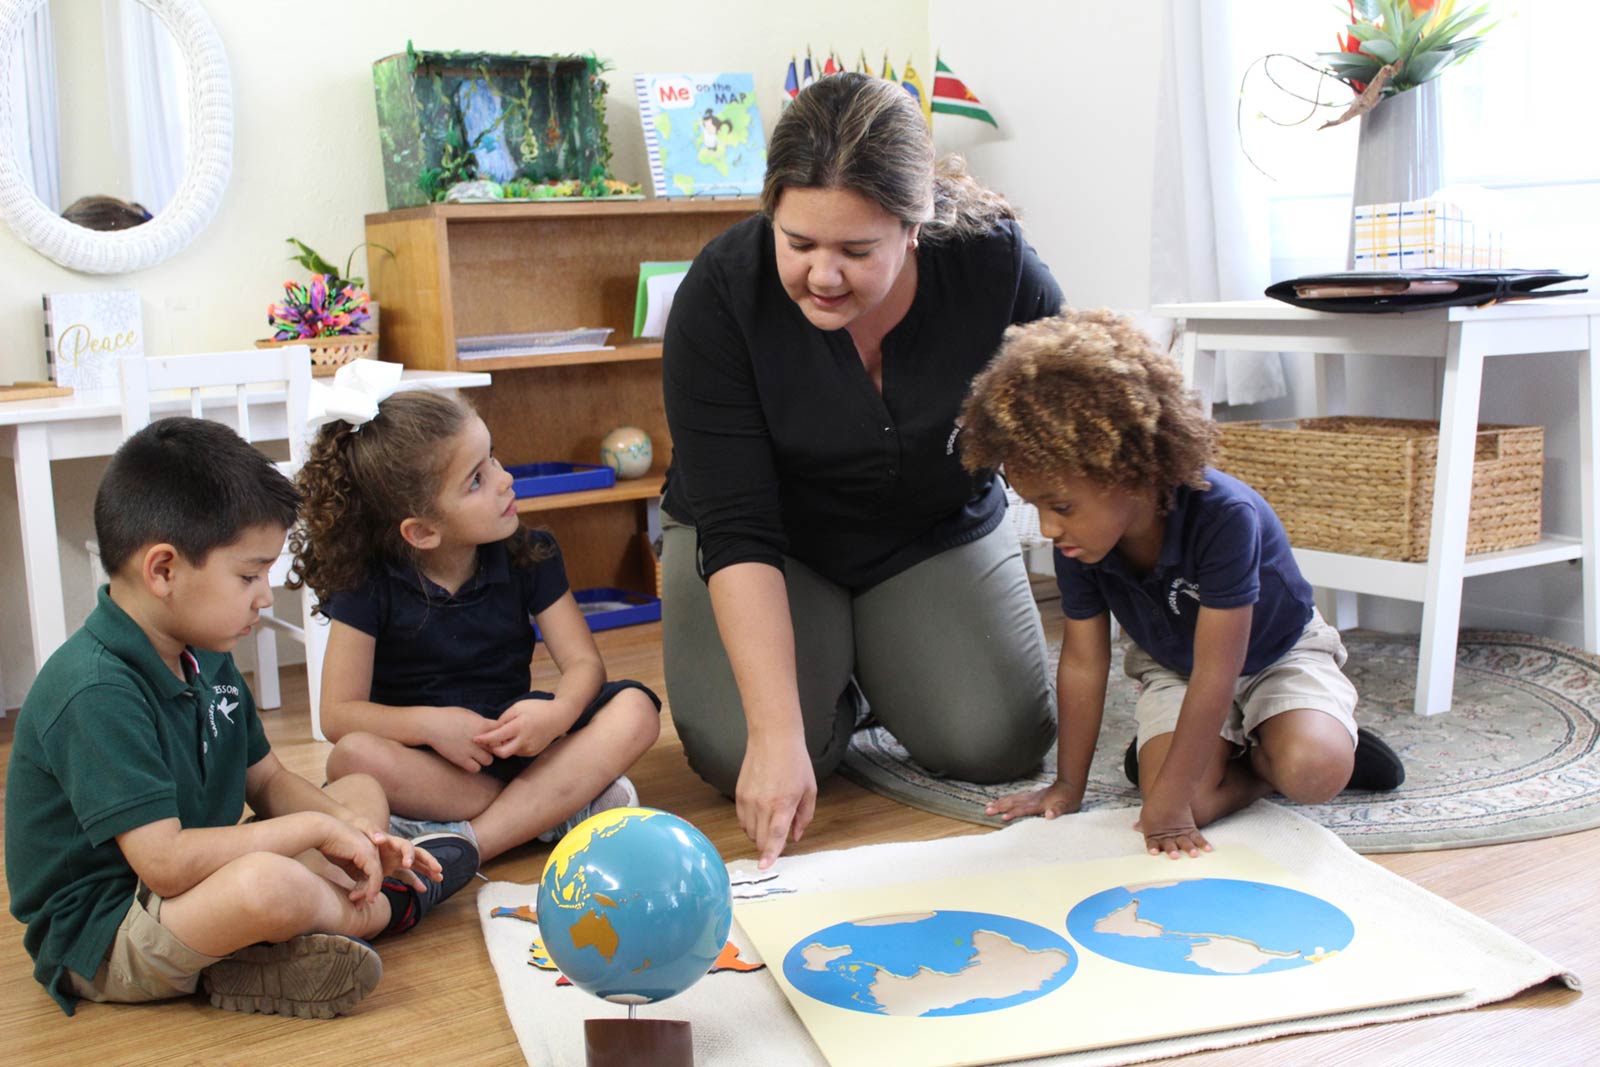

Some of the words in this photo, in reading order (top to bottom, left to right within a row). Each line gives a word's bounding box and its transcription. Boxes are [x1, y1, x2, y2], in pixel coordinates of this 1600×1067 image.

[659, 85, 691, 103] Me
[695, 83, 711, 93] on
[711, 82, 733, 92] the
[714, 92, 747, 105] MAP
[57, 323, 138, 369] Peace
